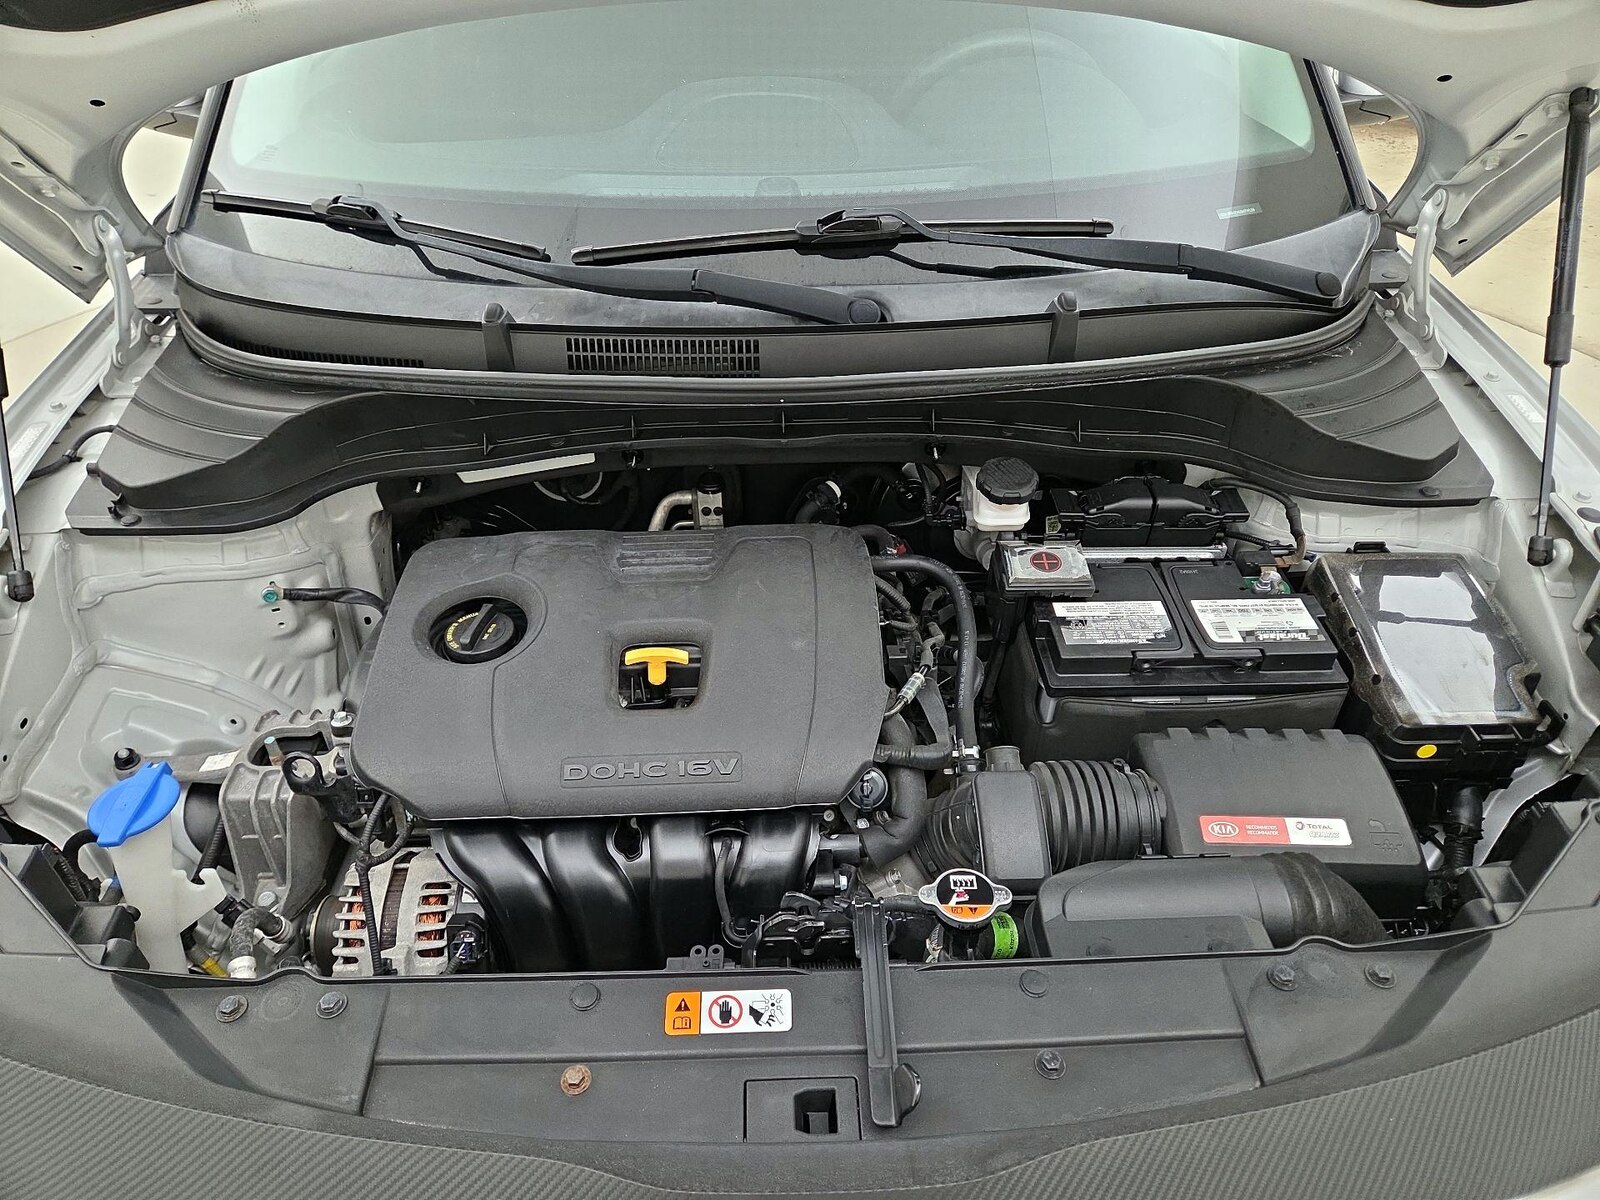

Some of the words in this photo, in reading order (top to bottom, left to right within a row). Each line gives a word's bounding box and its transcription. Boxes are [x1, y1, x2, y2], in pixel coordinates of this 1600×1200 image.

[1257, 630, 1311, 641] Duralast
[563, 761, 668, 782] DOHC
[676, 758, 739, 778] 16V
[1212, 824, 1235, 836] KIA
